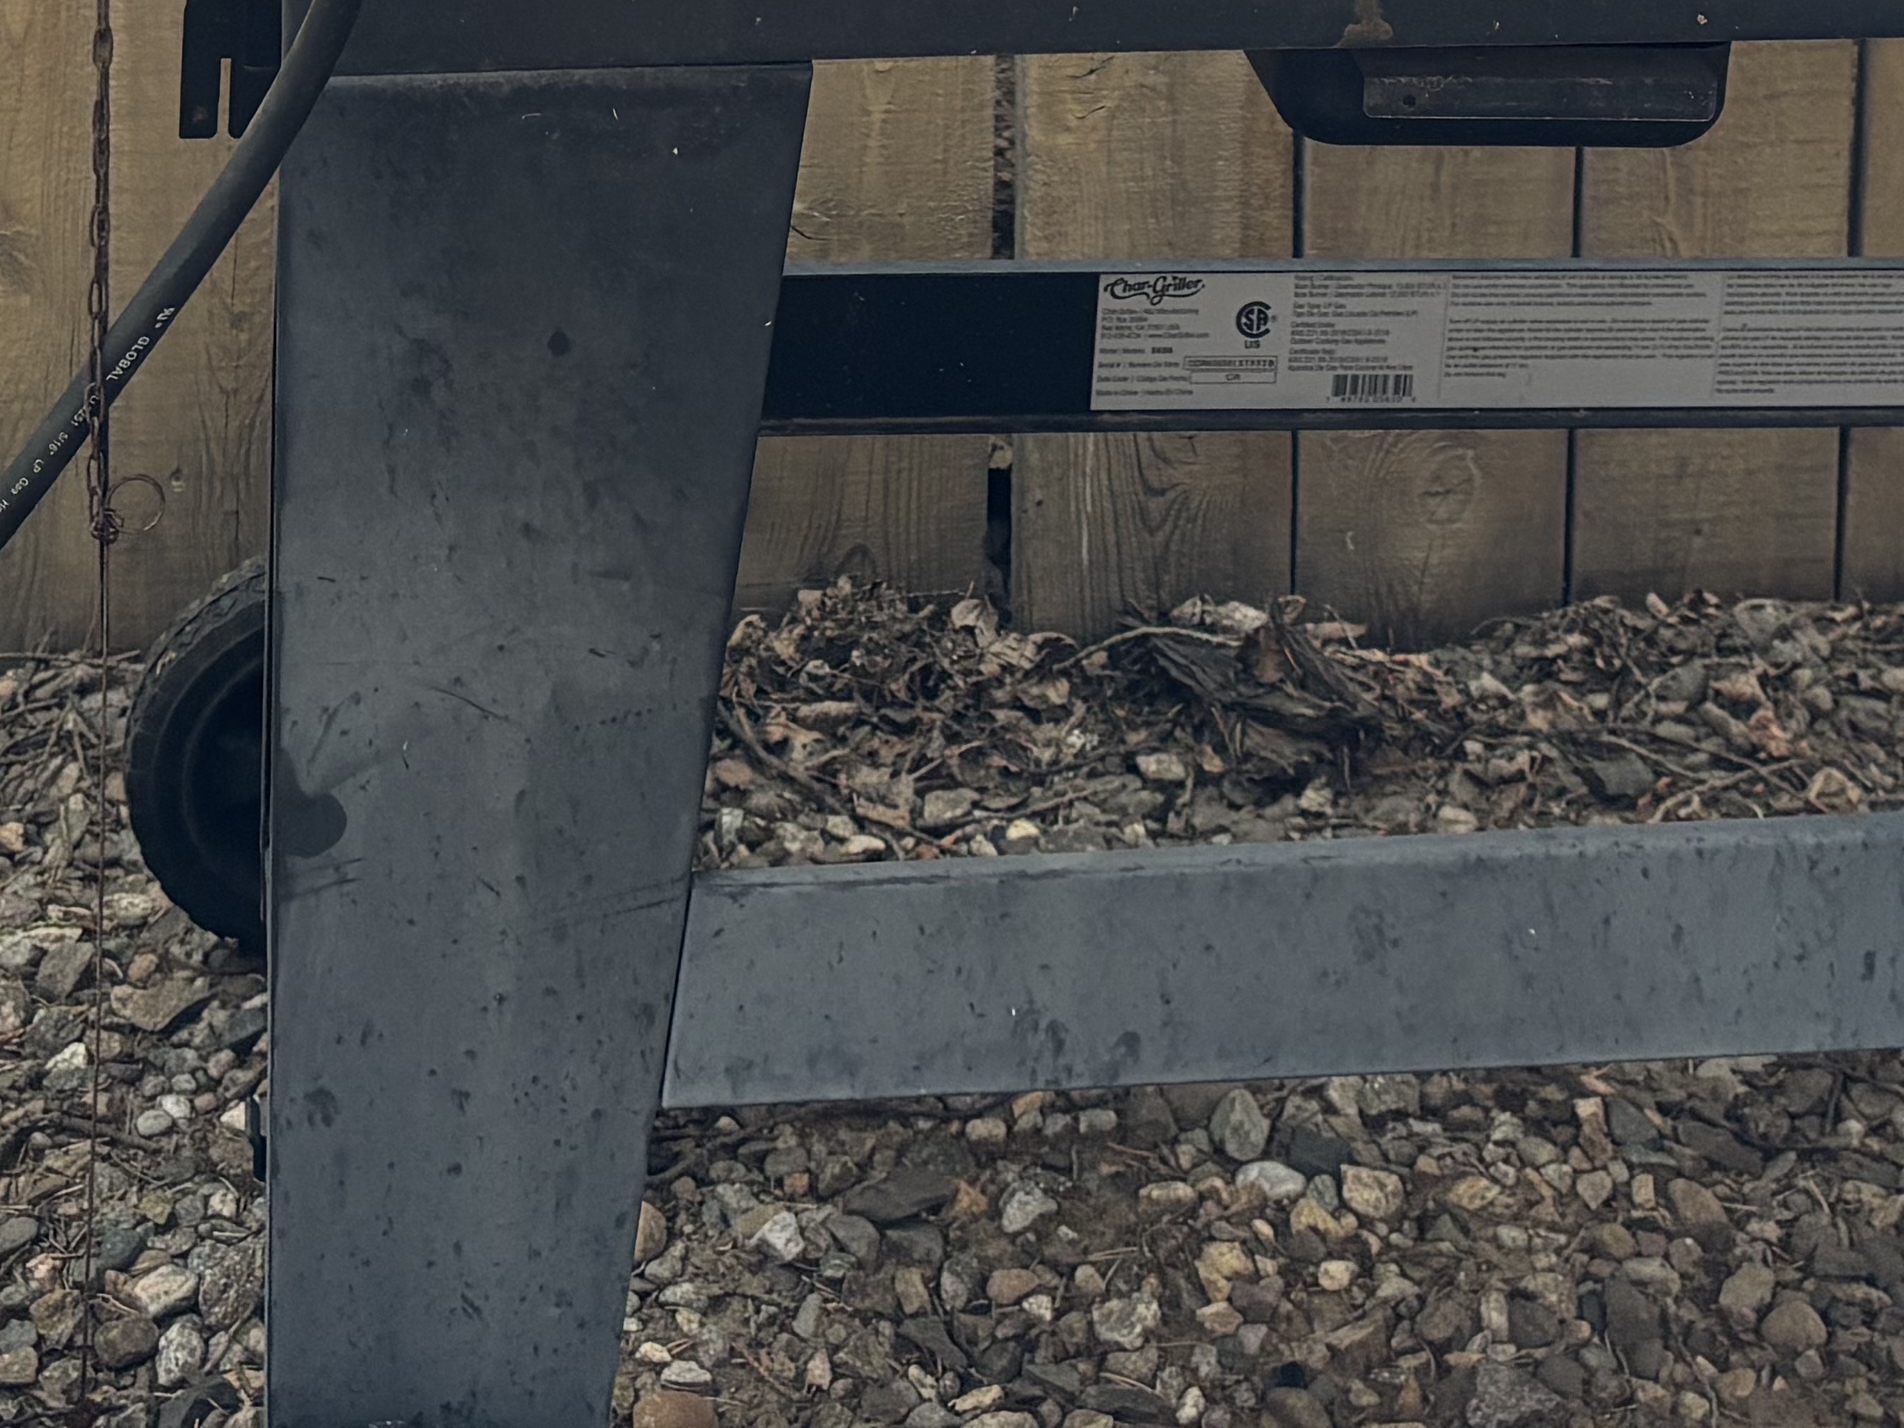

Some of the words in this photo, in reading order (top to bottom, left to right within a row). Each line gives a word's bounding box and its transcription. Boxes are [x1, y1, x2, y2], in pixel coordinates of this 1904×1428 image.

[1104, 275, 1205, 306] Char-Griller
[106, 336, 150, 381] GLOBAL
[33, 459, 44, 473] LP
[11, 478, 29, 495] Gas
